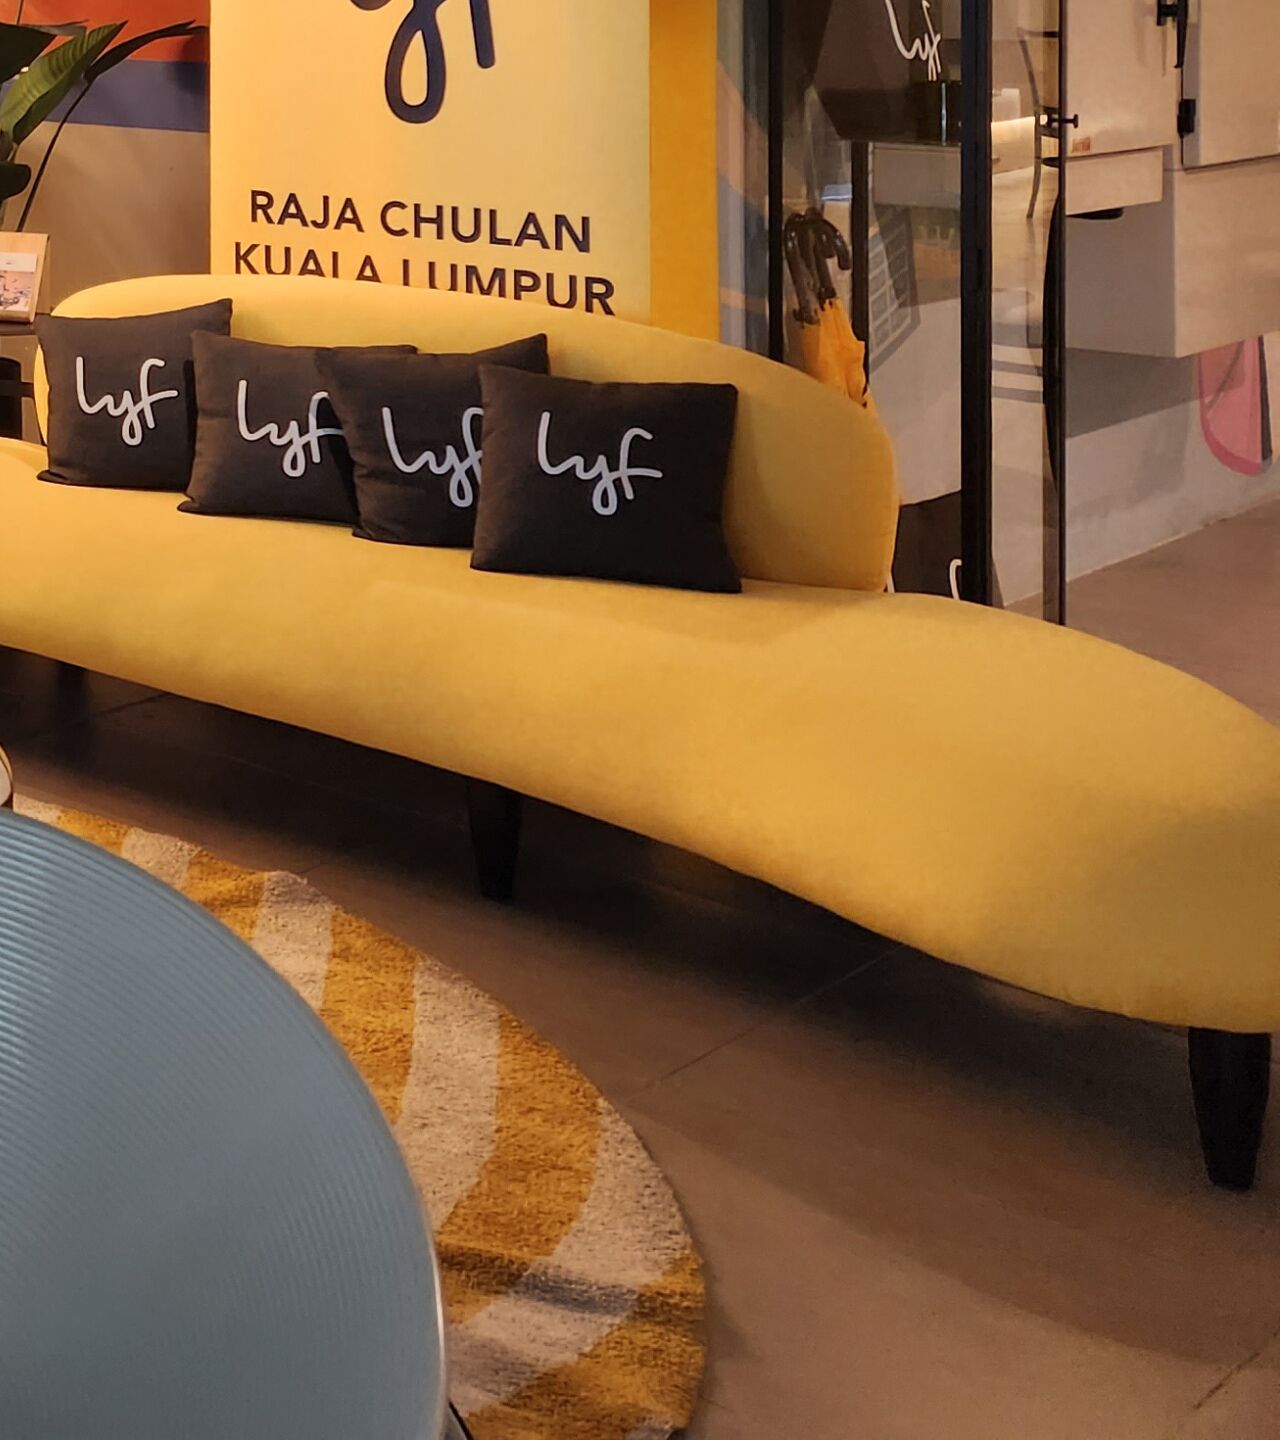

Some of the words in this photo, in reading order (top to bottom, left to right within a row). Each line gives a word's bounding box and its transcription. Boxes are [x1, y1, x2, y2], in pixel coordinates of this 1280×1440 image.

[250, 189, 364, 233] RAJA
[380, 201, 591, 253] CHULAN
[75, 356, 178, 446] lyf
[237, 379, 343, 478] lyf
[538, 411, 663, 516] lyf
